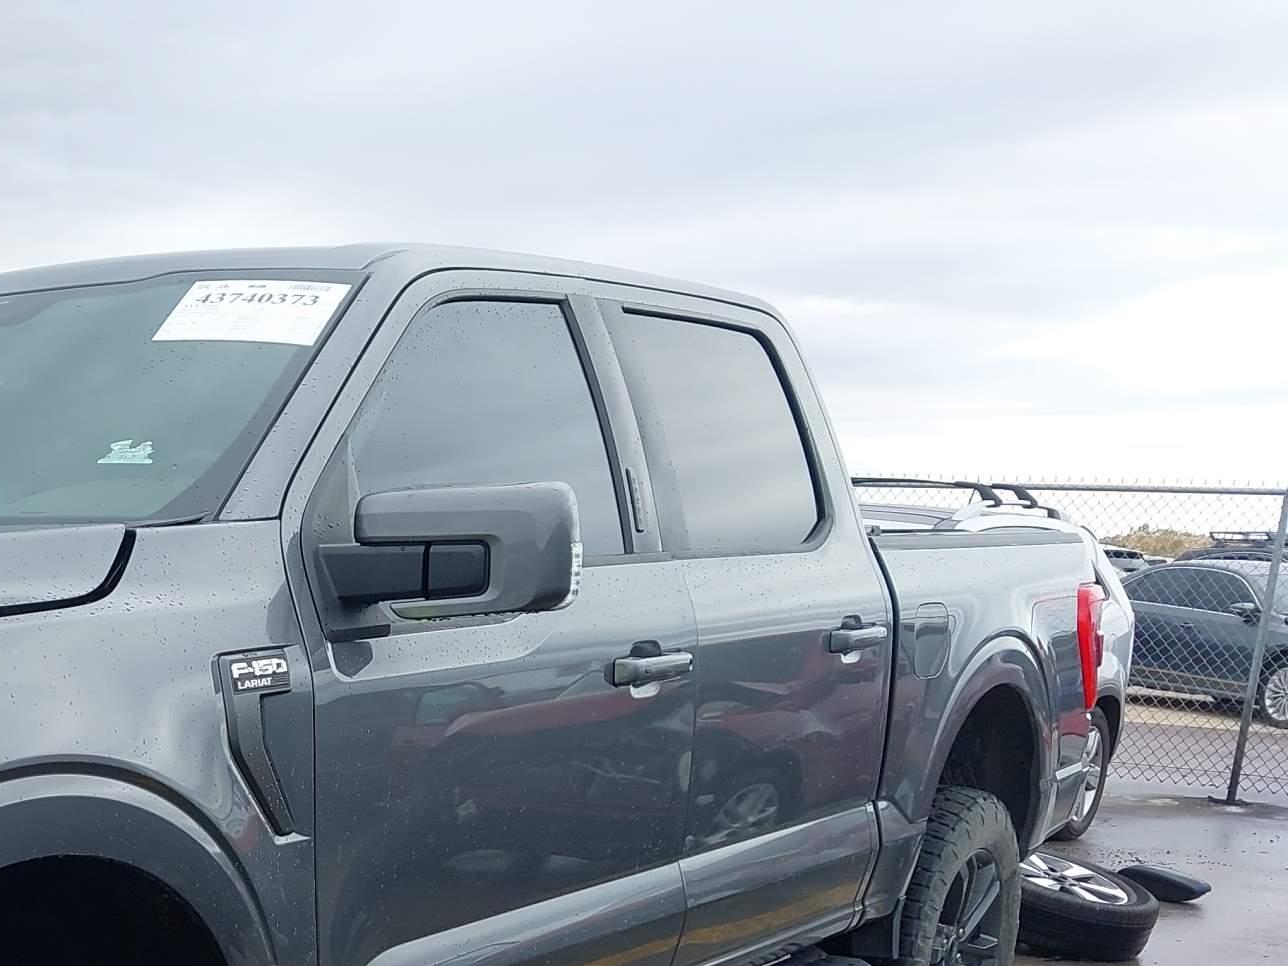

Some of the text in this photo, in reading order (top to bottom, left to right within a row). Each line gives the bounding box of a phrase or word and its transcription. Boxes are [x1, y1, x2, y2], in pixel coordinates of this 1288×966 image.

[195, 292, 320, 306] 43740373
[231, 658, 288, 679] F-150
[237, 677, 273, 690] LARIAT
